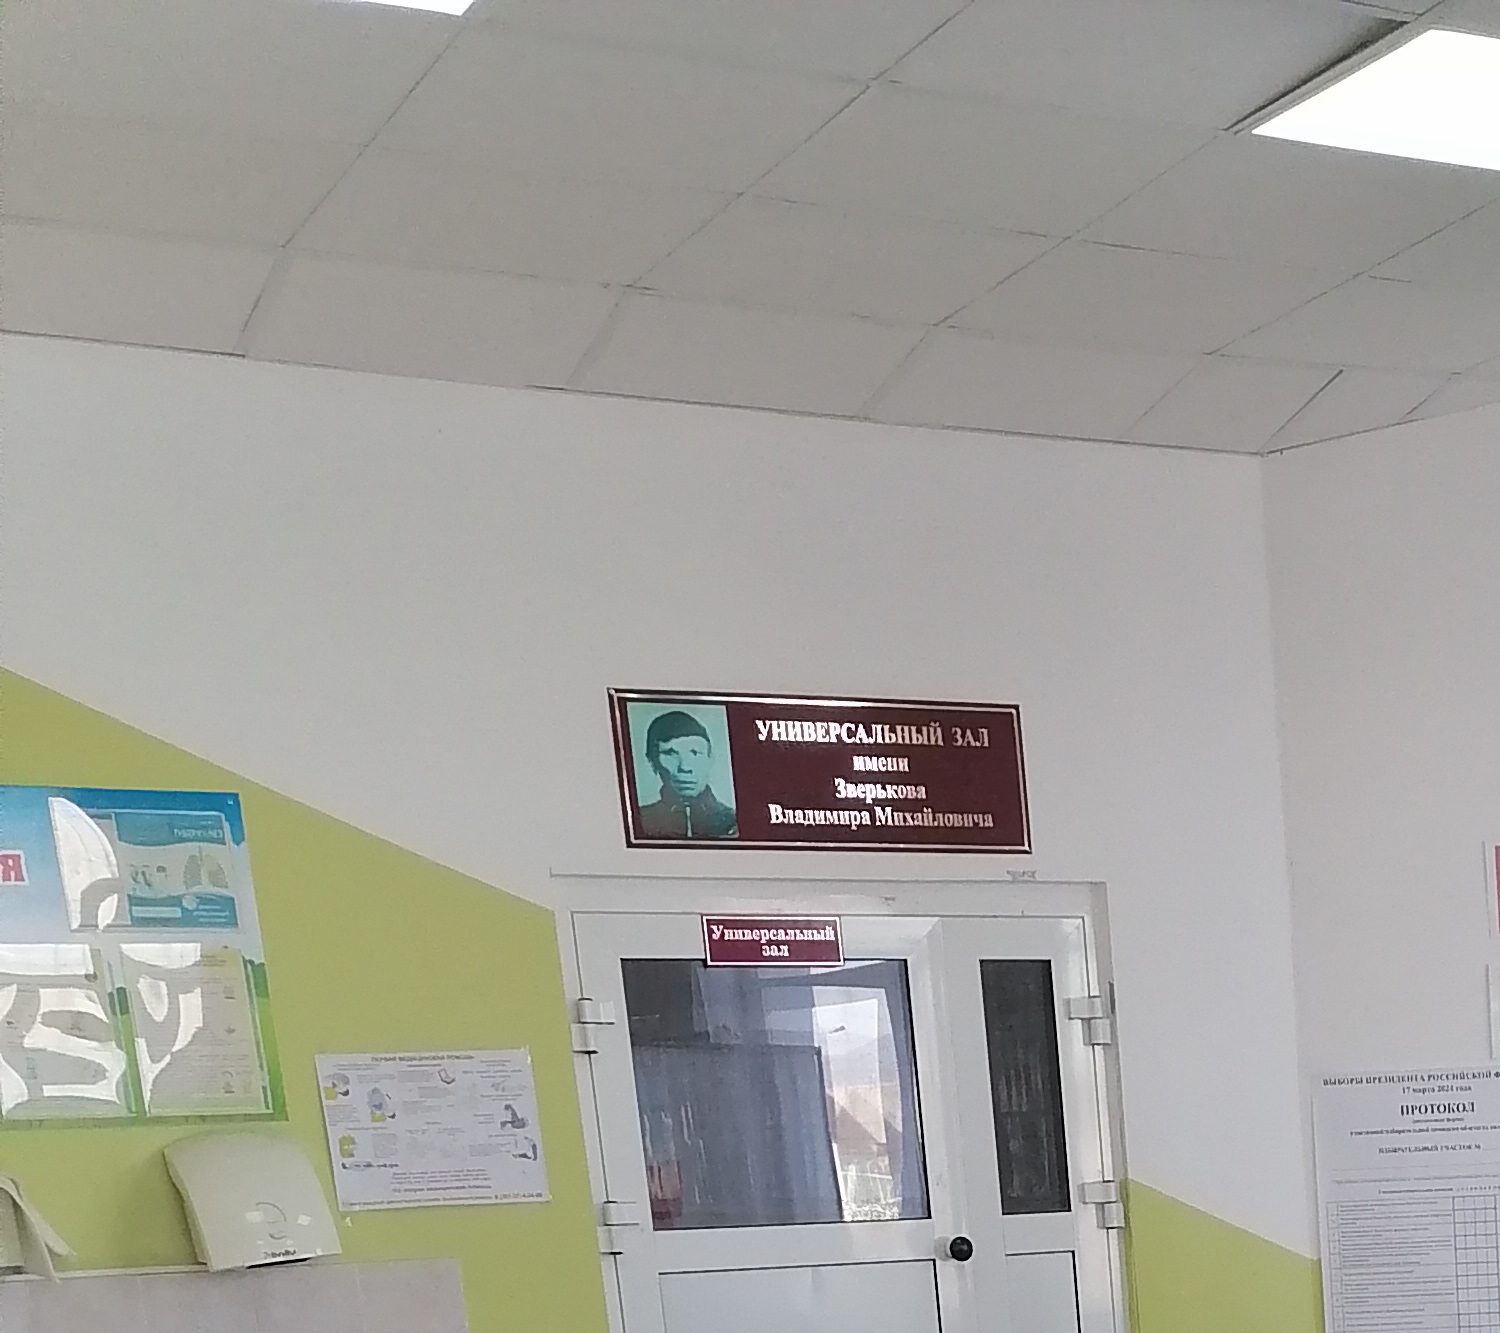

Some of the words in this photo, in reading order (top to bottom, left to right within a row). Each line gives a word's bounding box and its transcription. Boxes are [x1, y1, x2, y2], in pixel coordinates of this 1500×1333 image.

[755, 719, 945, 747] УНИВЕРСАЛЬНЫЙ
[951, 726, 990, 747] ЗАЛ
[853, 754, 910, 773] имени
[835, 778, 926, 803] Зверькова
[769, 804, 871, 831] Владимира
[875, 805, 993, 829] Михайловича
[710, 925, 836, 943] Универсальный
[761, 945, 790, 957] зал
[1400, 1101, 1476, 1117] ПРОТОКОЛ
